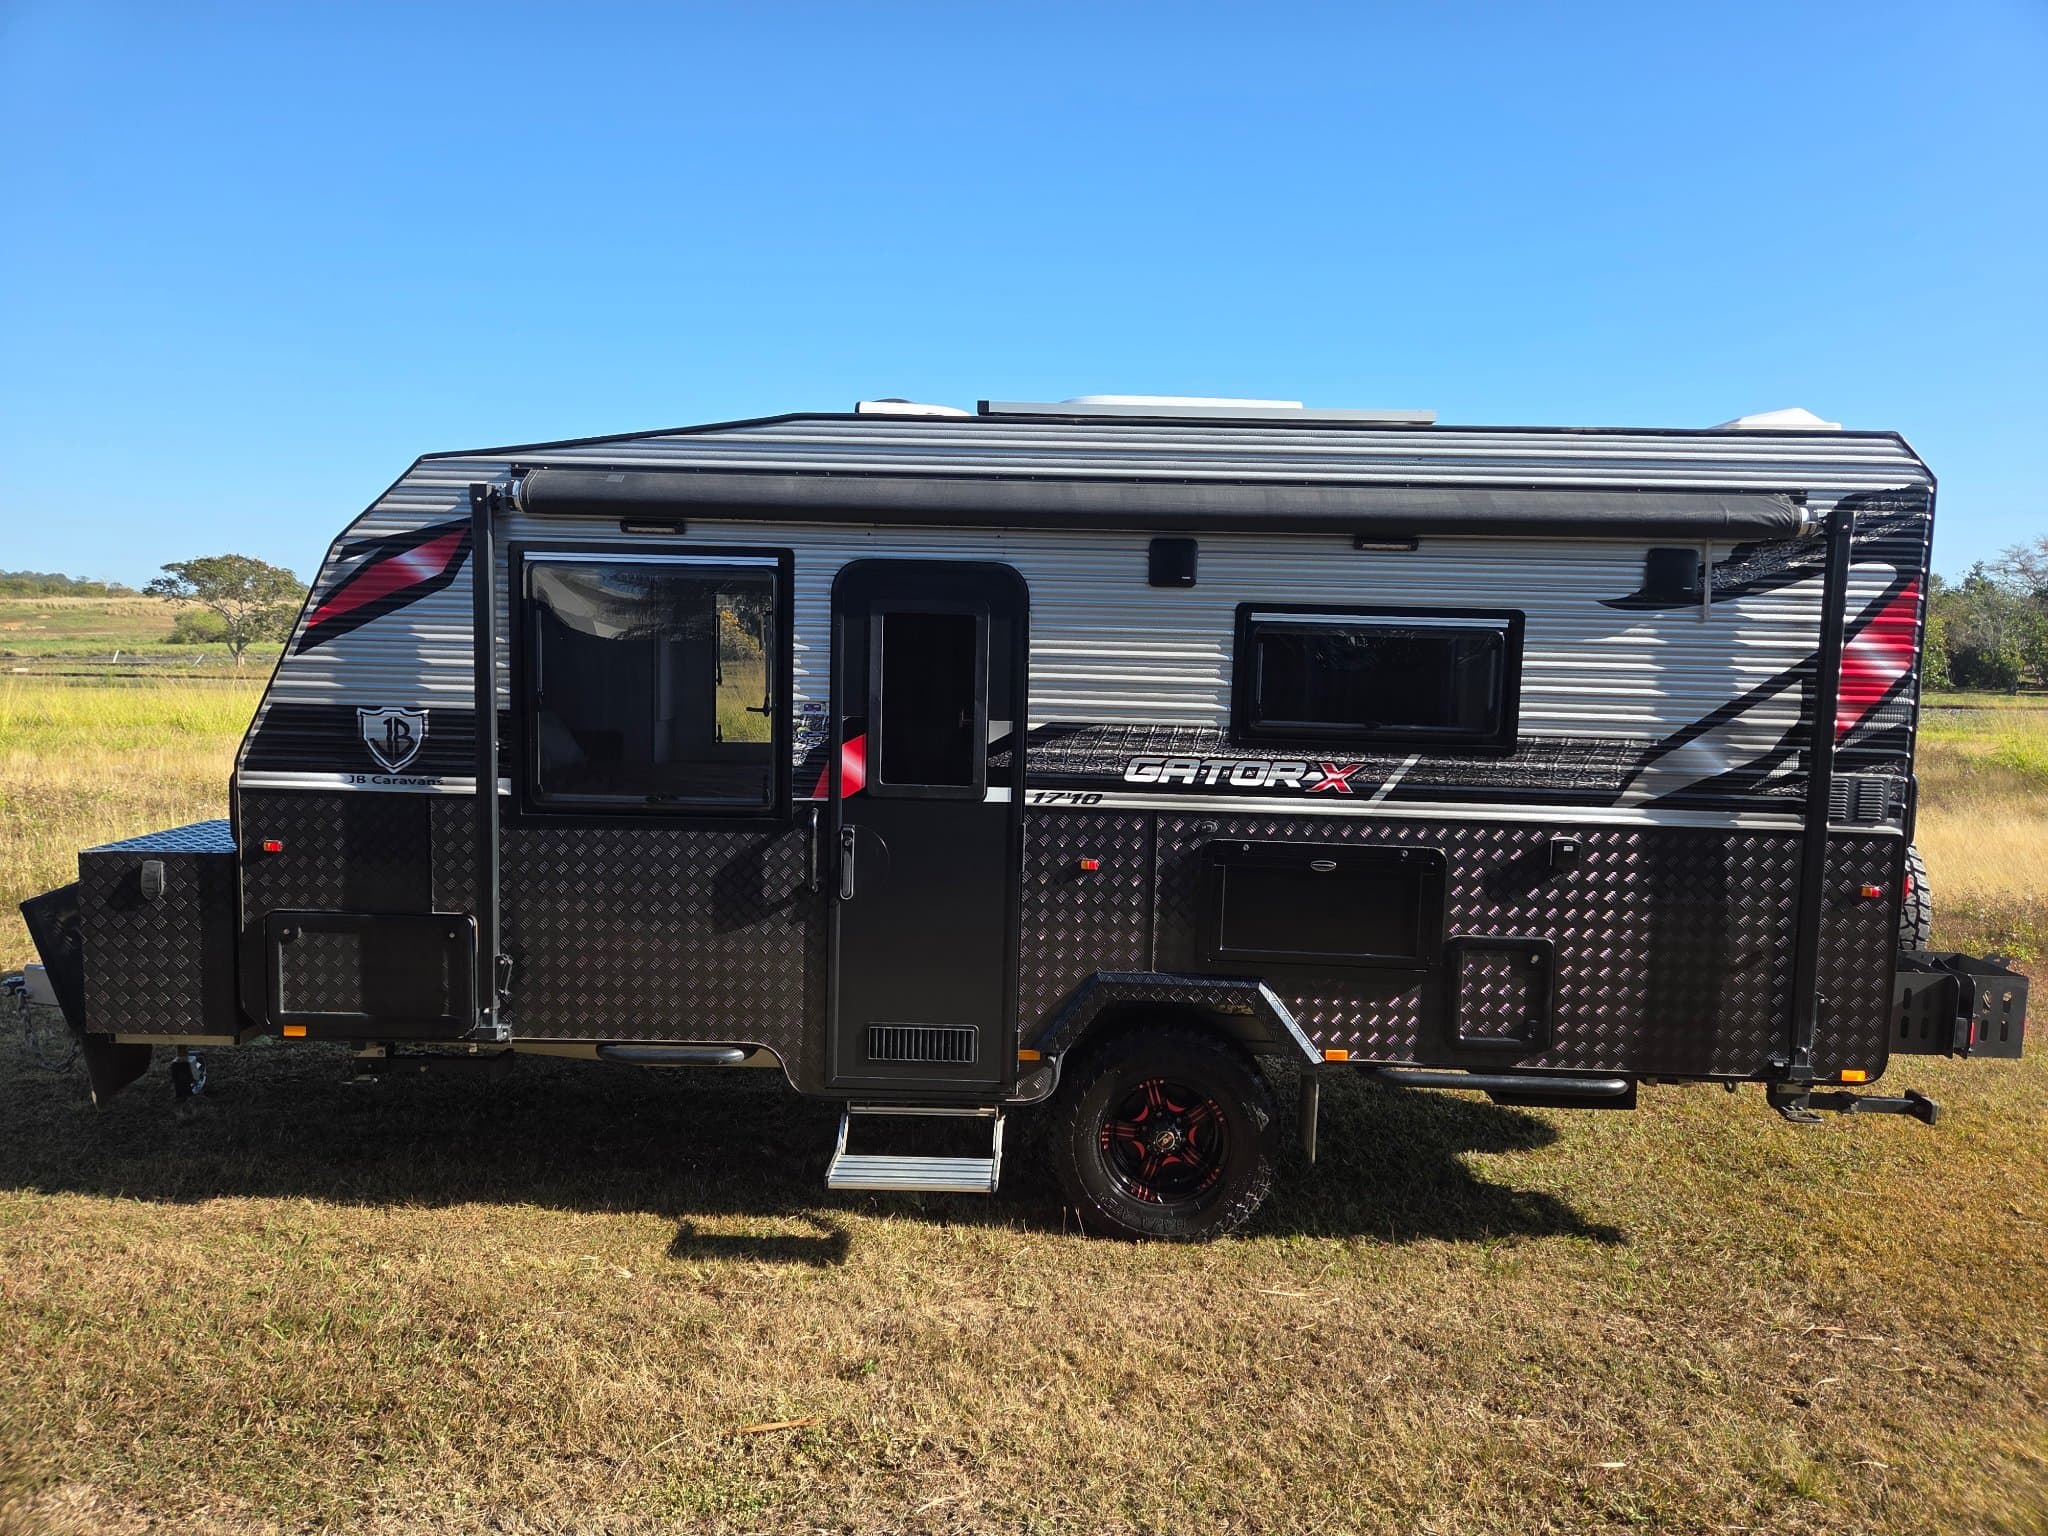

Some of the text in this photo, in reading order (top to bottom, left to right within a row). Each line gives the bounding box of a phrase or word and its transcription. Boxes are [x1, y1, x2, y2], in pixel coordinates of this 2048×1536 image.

[348, 775, 445, 785] JB Caravans
[1123, 757, 1366, 794] GATOR-X
